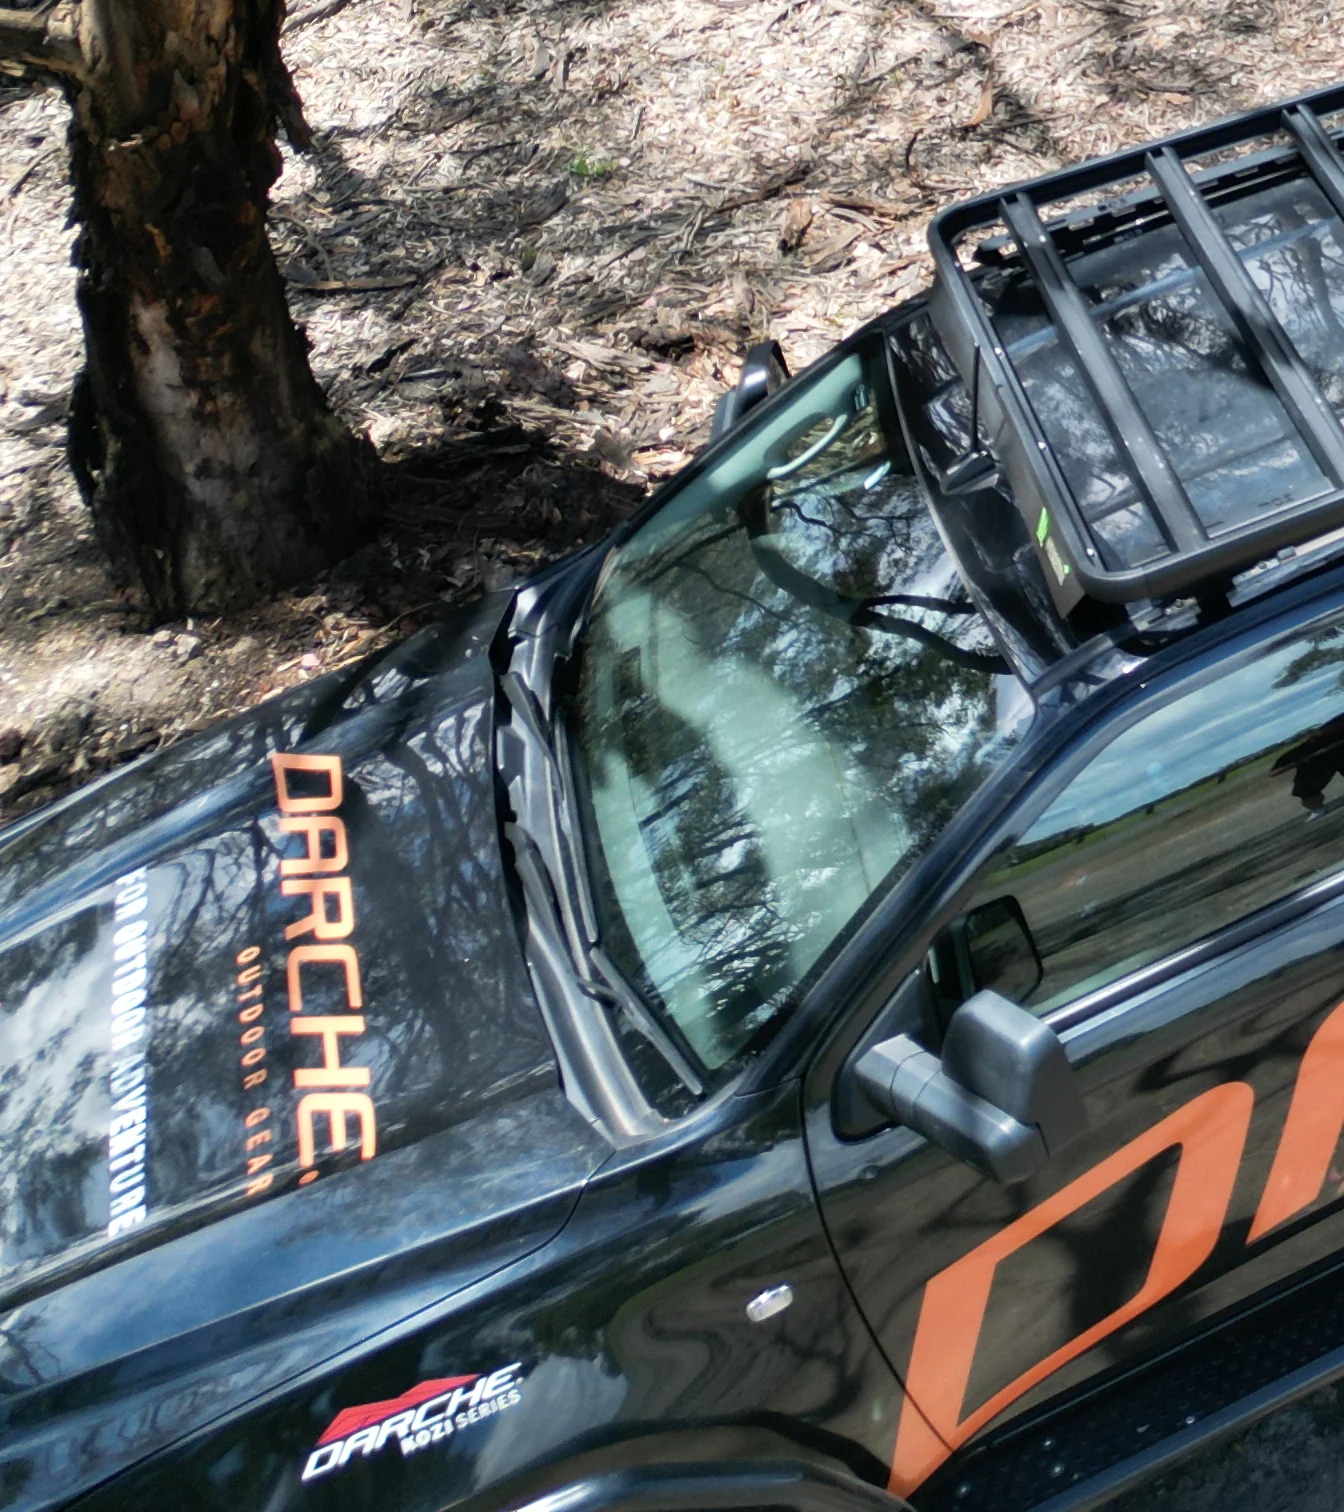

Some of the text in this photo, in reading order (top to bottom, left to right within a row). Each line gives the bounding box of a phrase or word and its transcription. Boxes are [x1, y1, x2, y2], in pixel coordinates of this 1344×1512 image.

[112, 919, 148, 1052] OUTDOOR
[271, 752, 377, 1168] DARCHE
[108, 1052, 148, 1238] ADVENTURE
[236, 945, 275, 1197] OUTDOOR GEAR
[301, 1362, 523, 1482] DARCHE
[400, 1389, 522, 1457] KOZI SERIES
